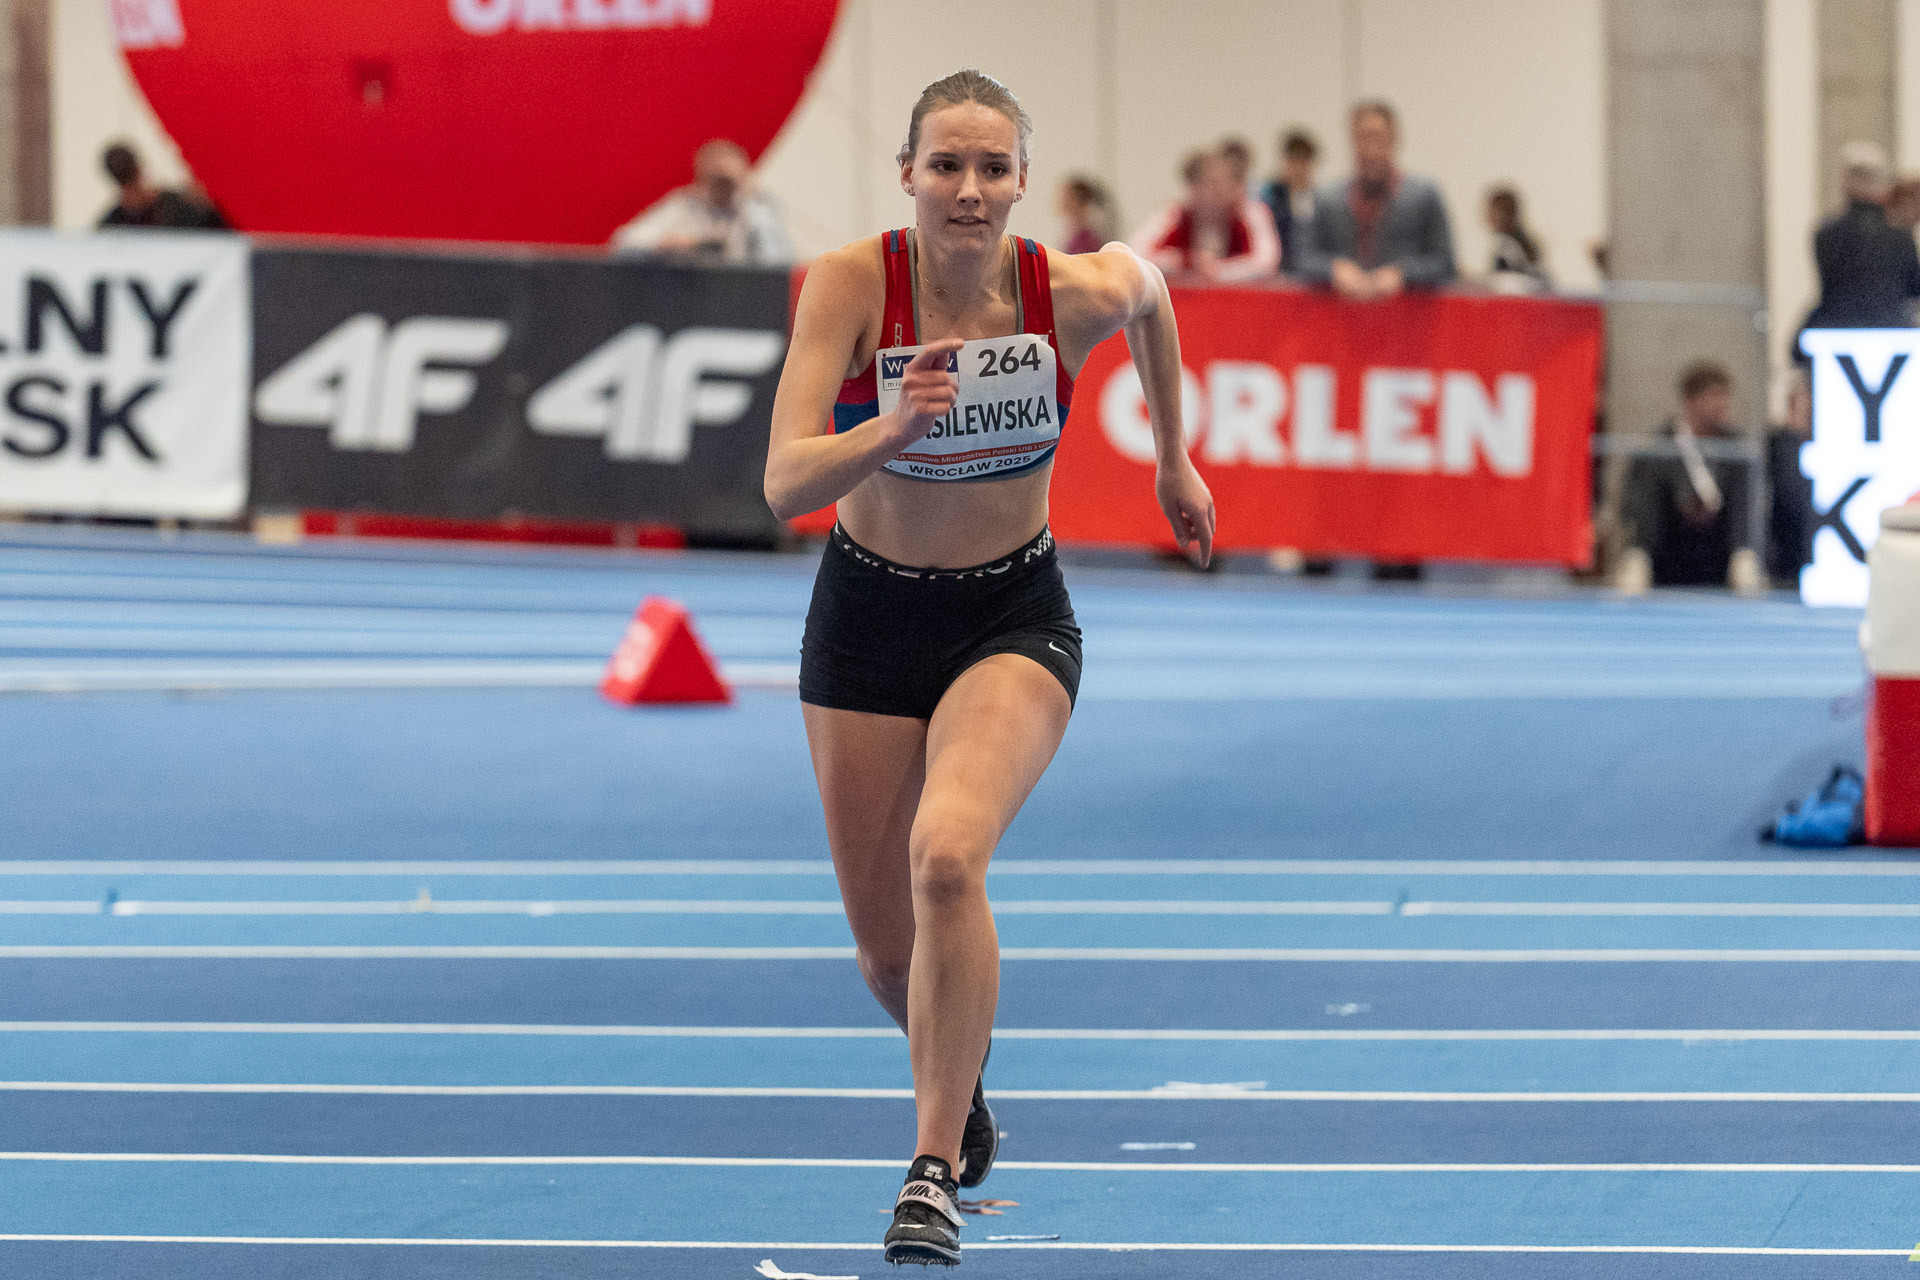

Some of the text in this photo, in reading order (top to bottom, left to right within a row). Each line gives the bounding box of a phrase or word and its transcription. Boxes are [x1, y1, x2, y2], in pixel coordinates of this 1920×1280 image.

[0, 275, 199, 358] NY
[255, 314, 510, 450] 4F
[977, 343, 1041, 378] 264
[526, 326, 784, 462] 4F
[925, 395, 1052, 439] SILEWSKA
[1101, 360, 1535, 477] ORLEN
[908, 454, 940, 463] Halowe
[941, 450, 991, 464] Mistrzostwa
[992, 447, 1017, 456] Polski
[908, 455, 1031, 477] WROCŁAW 2025
[901, 1184, 943, 1203] NIKE
